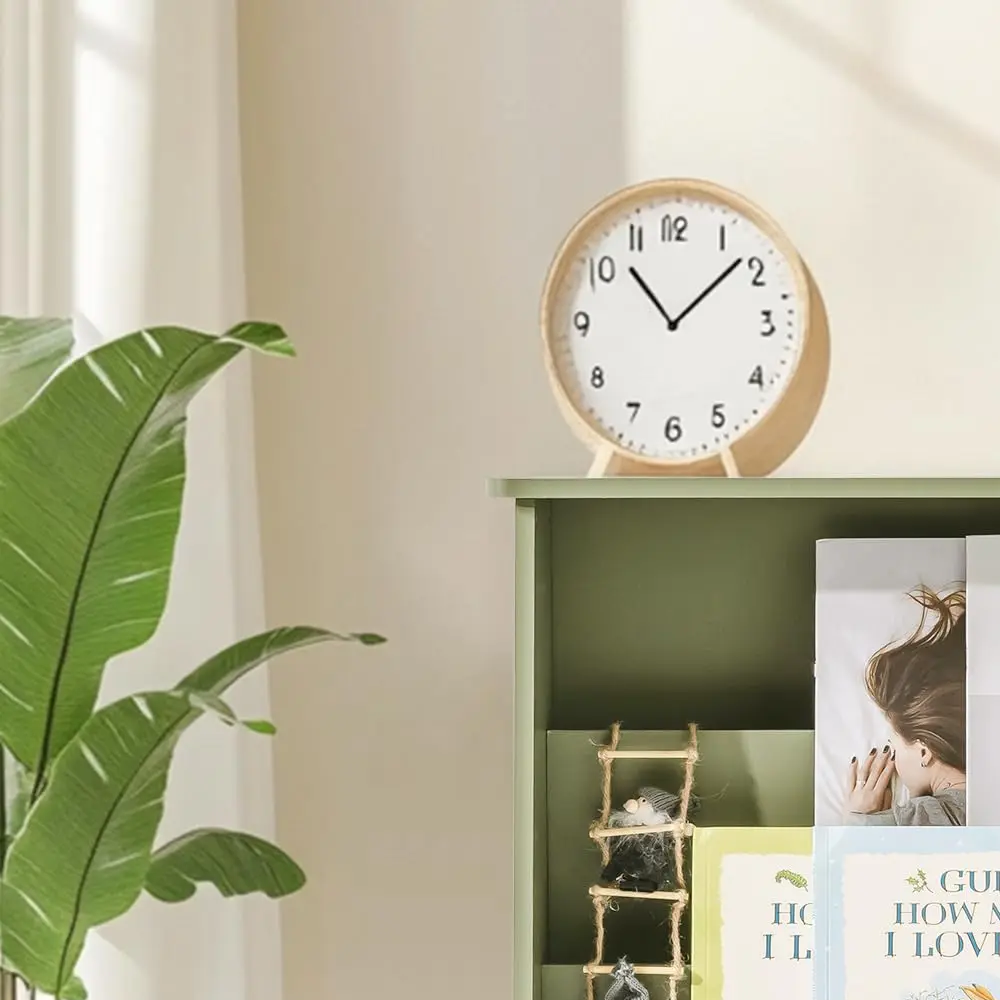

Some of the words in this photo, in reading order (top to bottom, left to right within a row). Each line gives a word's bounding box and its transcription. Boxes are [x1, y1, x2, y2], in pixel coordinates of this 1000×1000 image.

[719, 224, 726, 251] 1
[589, 255, 615, 291] 10
[748, 257, 765, 286] 2
[574, 311, 590, 337] 9
[760, 310, 775, 336] 3
[591, 366, 604, 388] 8
[748, 365, 764, 389] 4
[626, 402, 641, 422] 7
[711, 404, 725, 427] 5
[665, 416, 682, 442] 6
[893, 902, 980, 925] HOW
[763, 934, 775, 960] I
[884, 931, 896, 957] I
